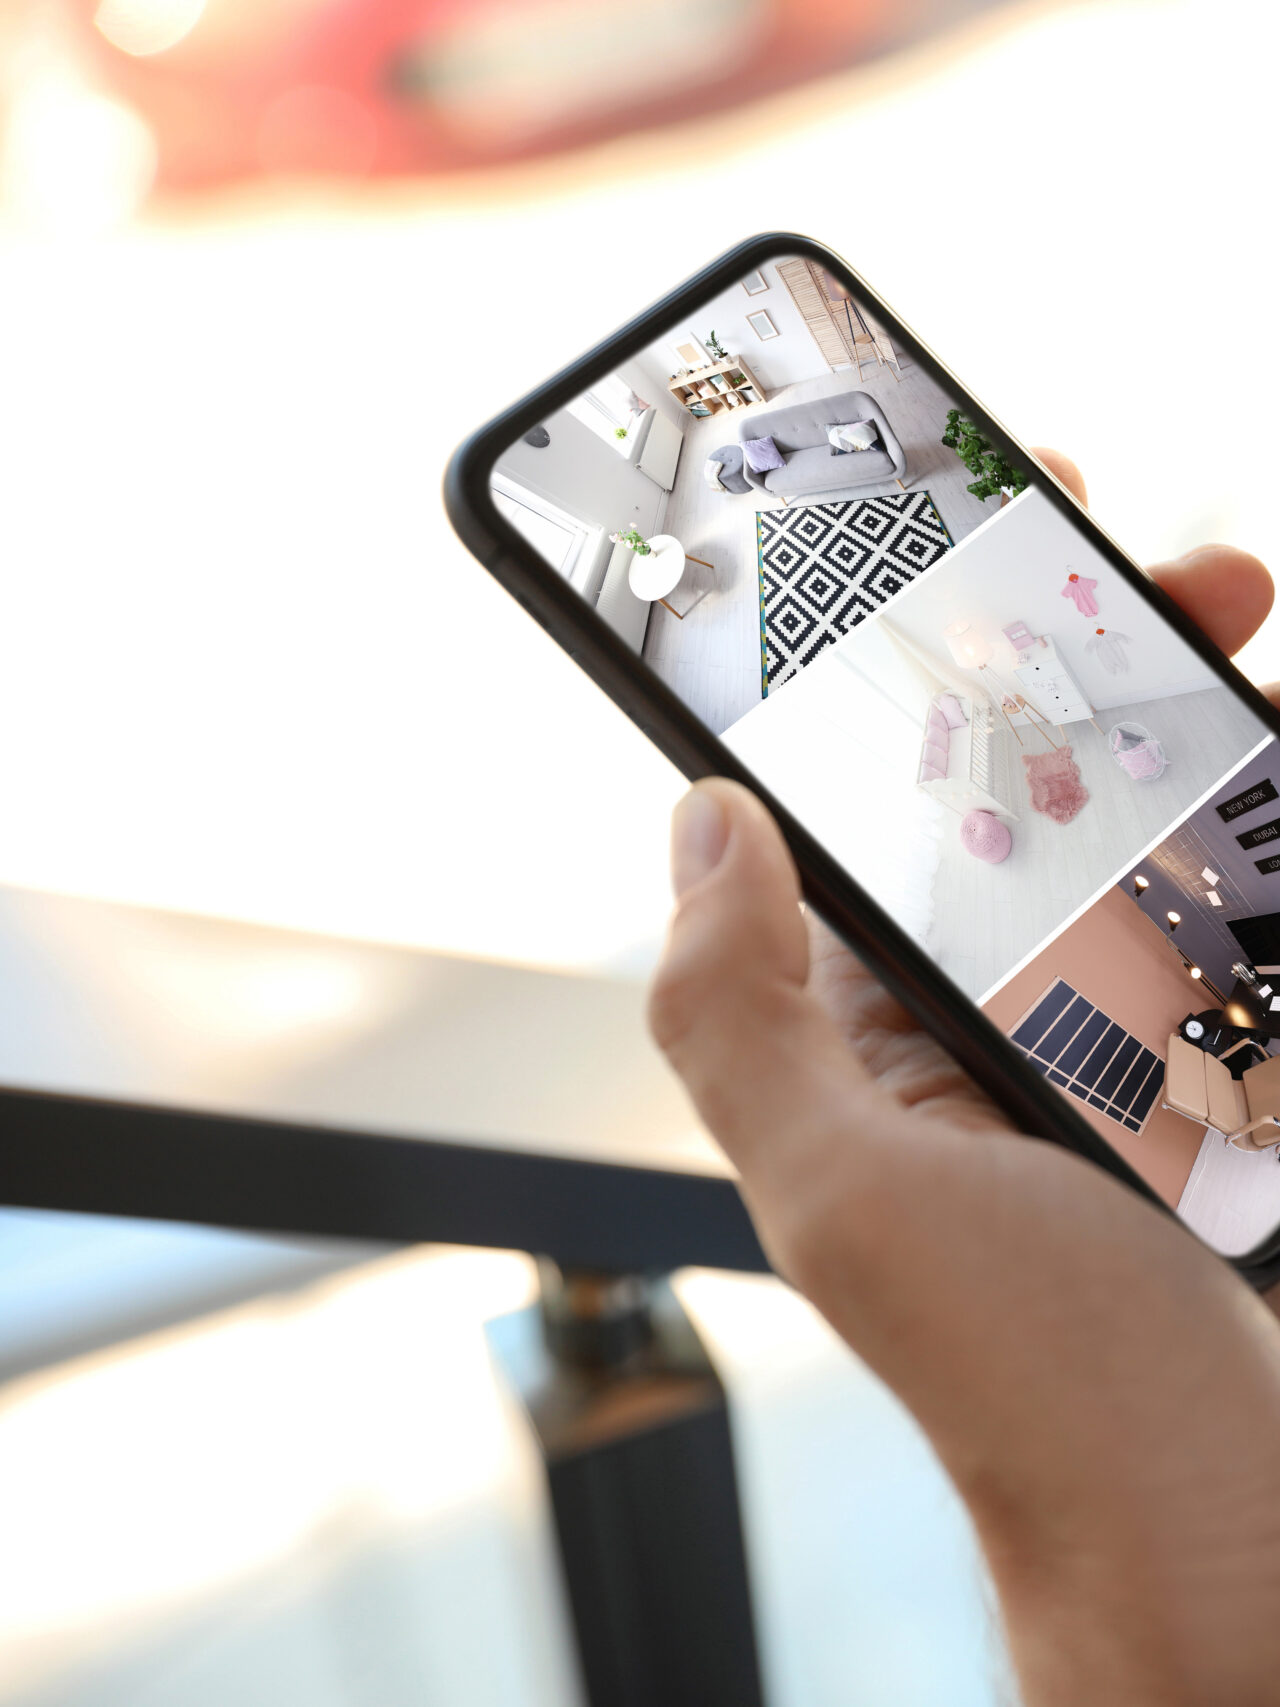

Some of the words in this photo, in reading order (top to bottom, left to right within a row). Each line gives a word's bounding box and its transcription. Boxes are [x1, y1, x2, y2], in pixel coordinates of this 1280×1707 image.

[1226, 801, 1244, 815] NEW
[1242, 789, 1266, 806] YORK
[1252, 826, 1278, 842] DUBAI
